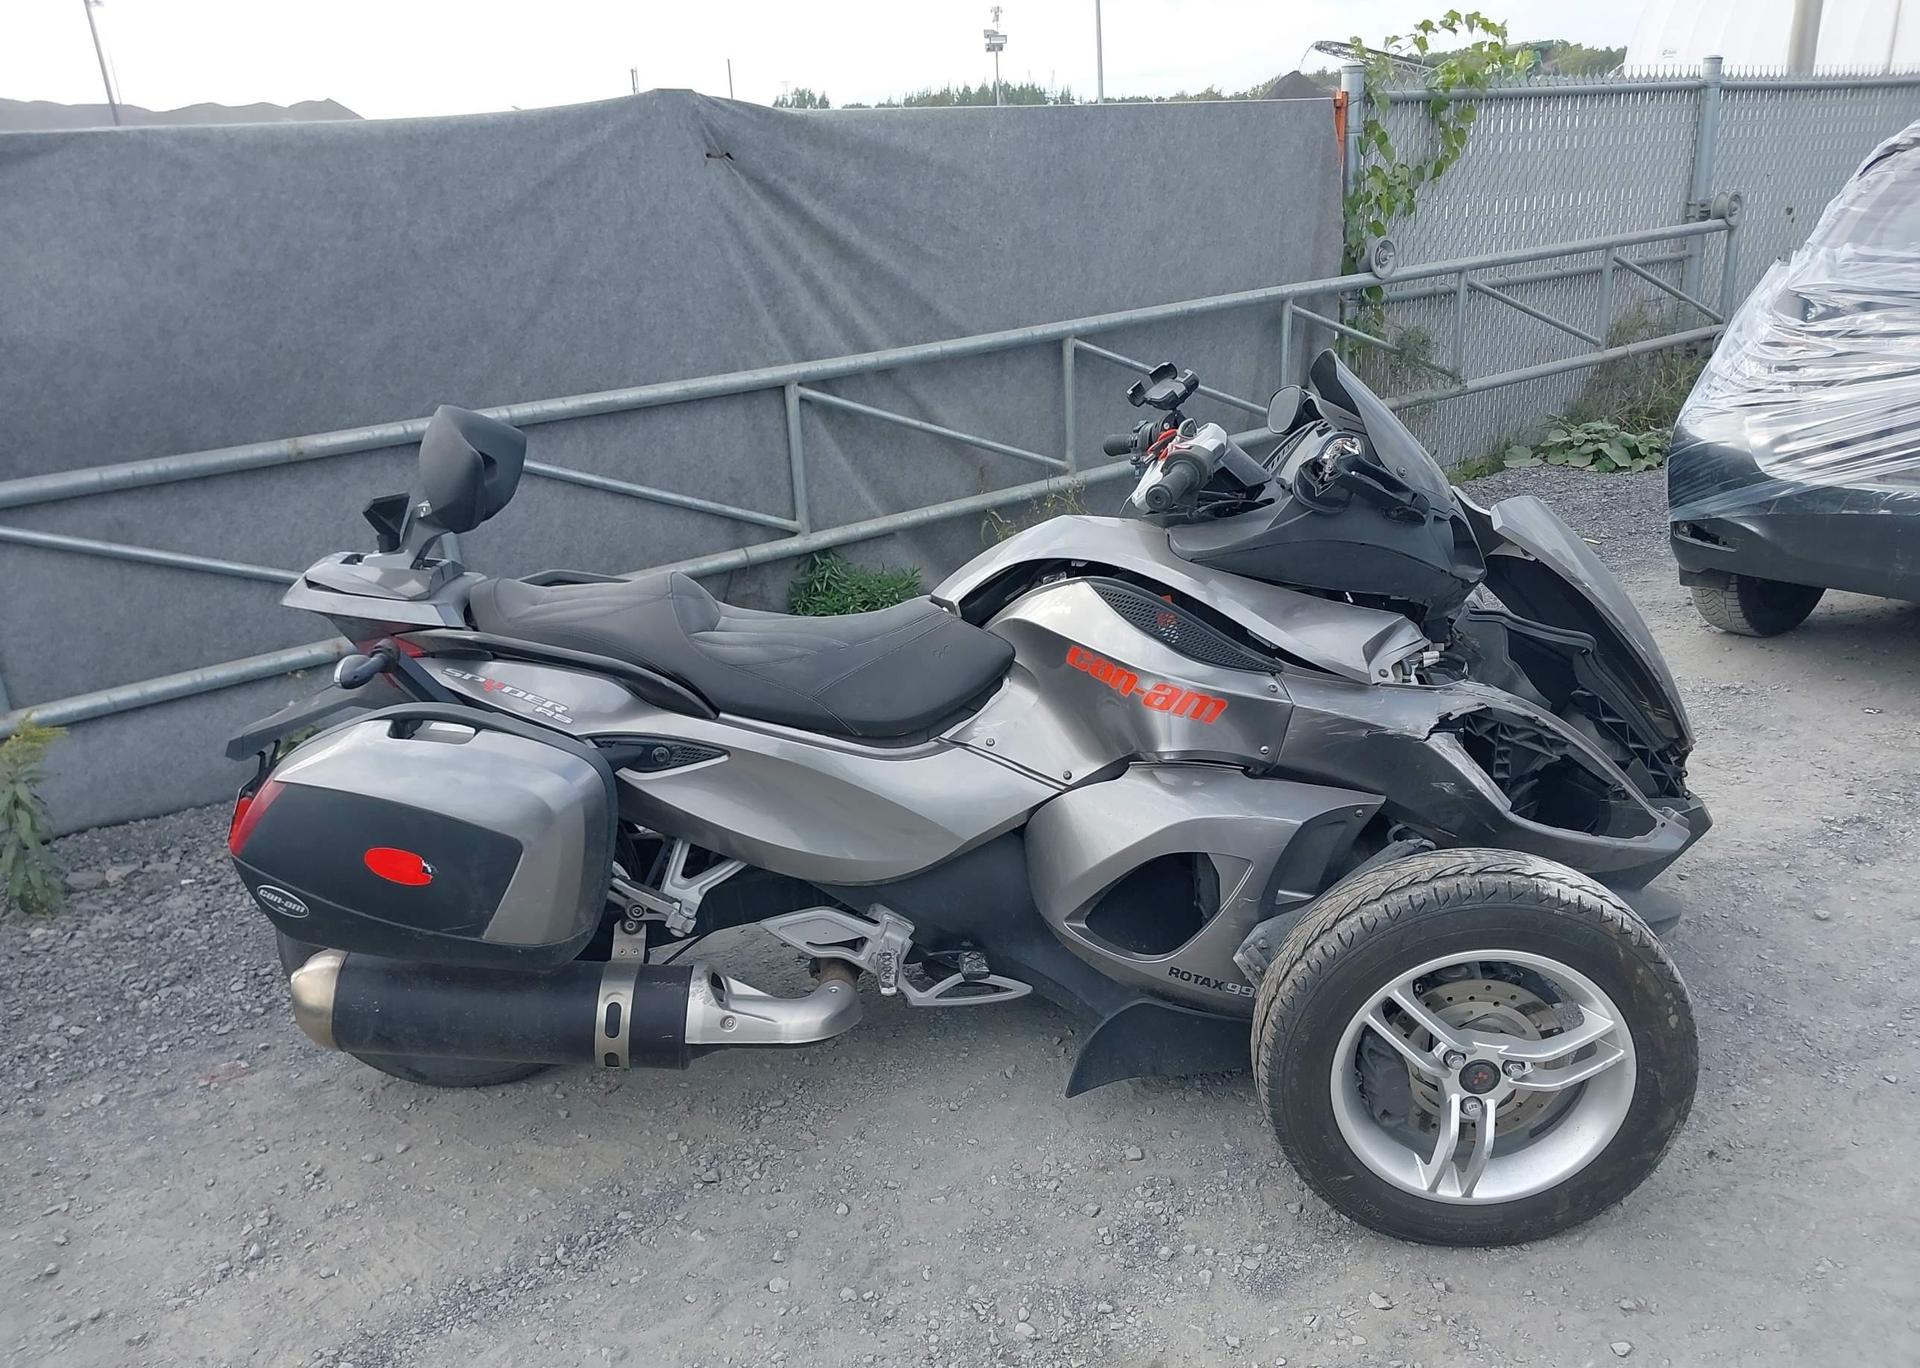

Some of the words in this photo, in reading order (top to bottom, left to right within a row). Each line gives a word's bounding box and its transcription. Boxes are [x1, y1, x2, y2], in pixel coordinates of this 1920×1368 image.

[443, 668, 569, 713] SPYDER
[1066, 646, 1228, 724] can-am
[535, 707, 574, 724] RS
[259, 889, 305, 912] can-am
[1168, 966, 1225, 991] ROTAX
[1226, 983, 1257, 998] 99
